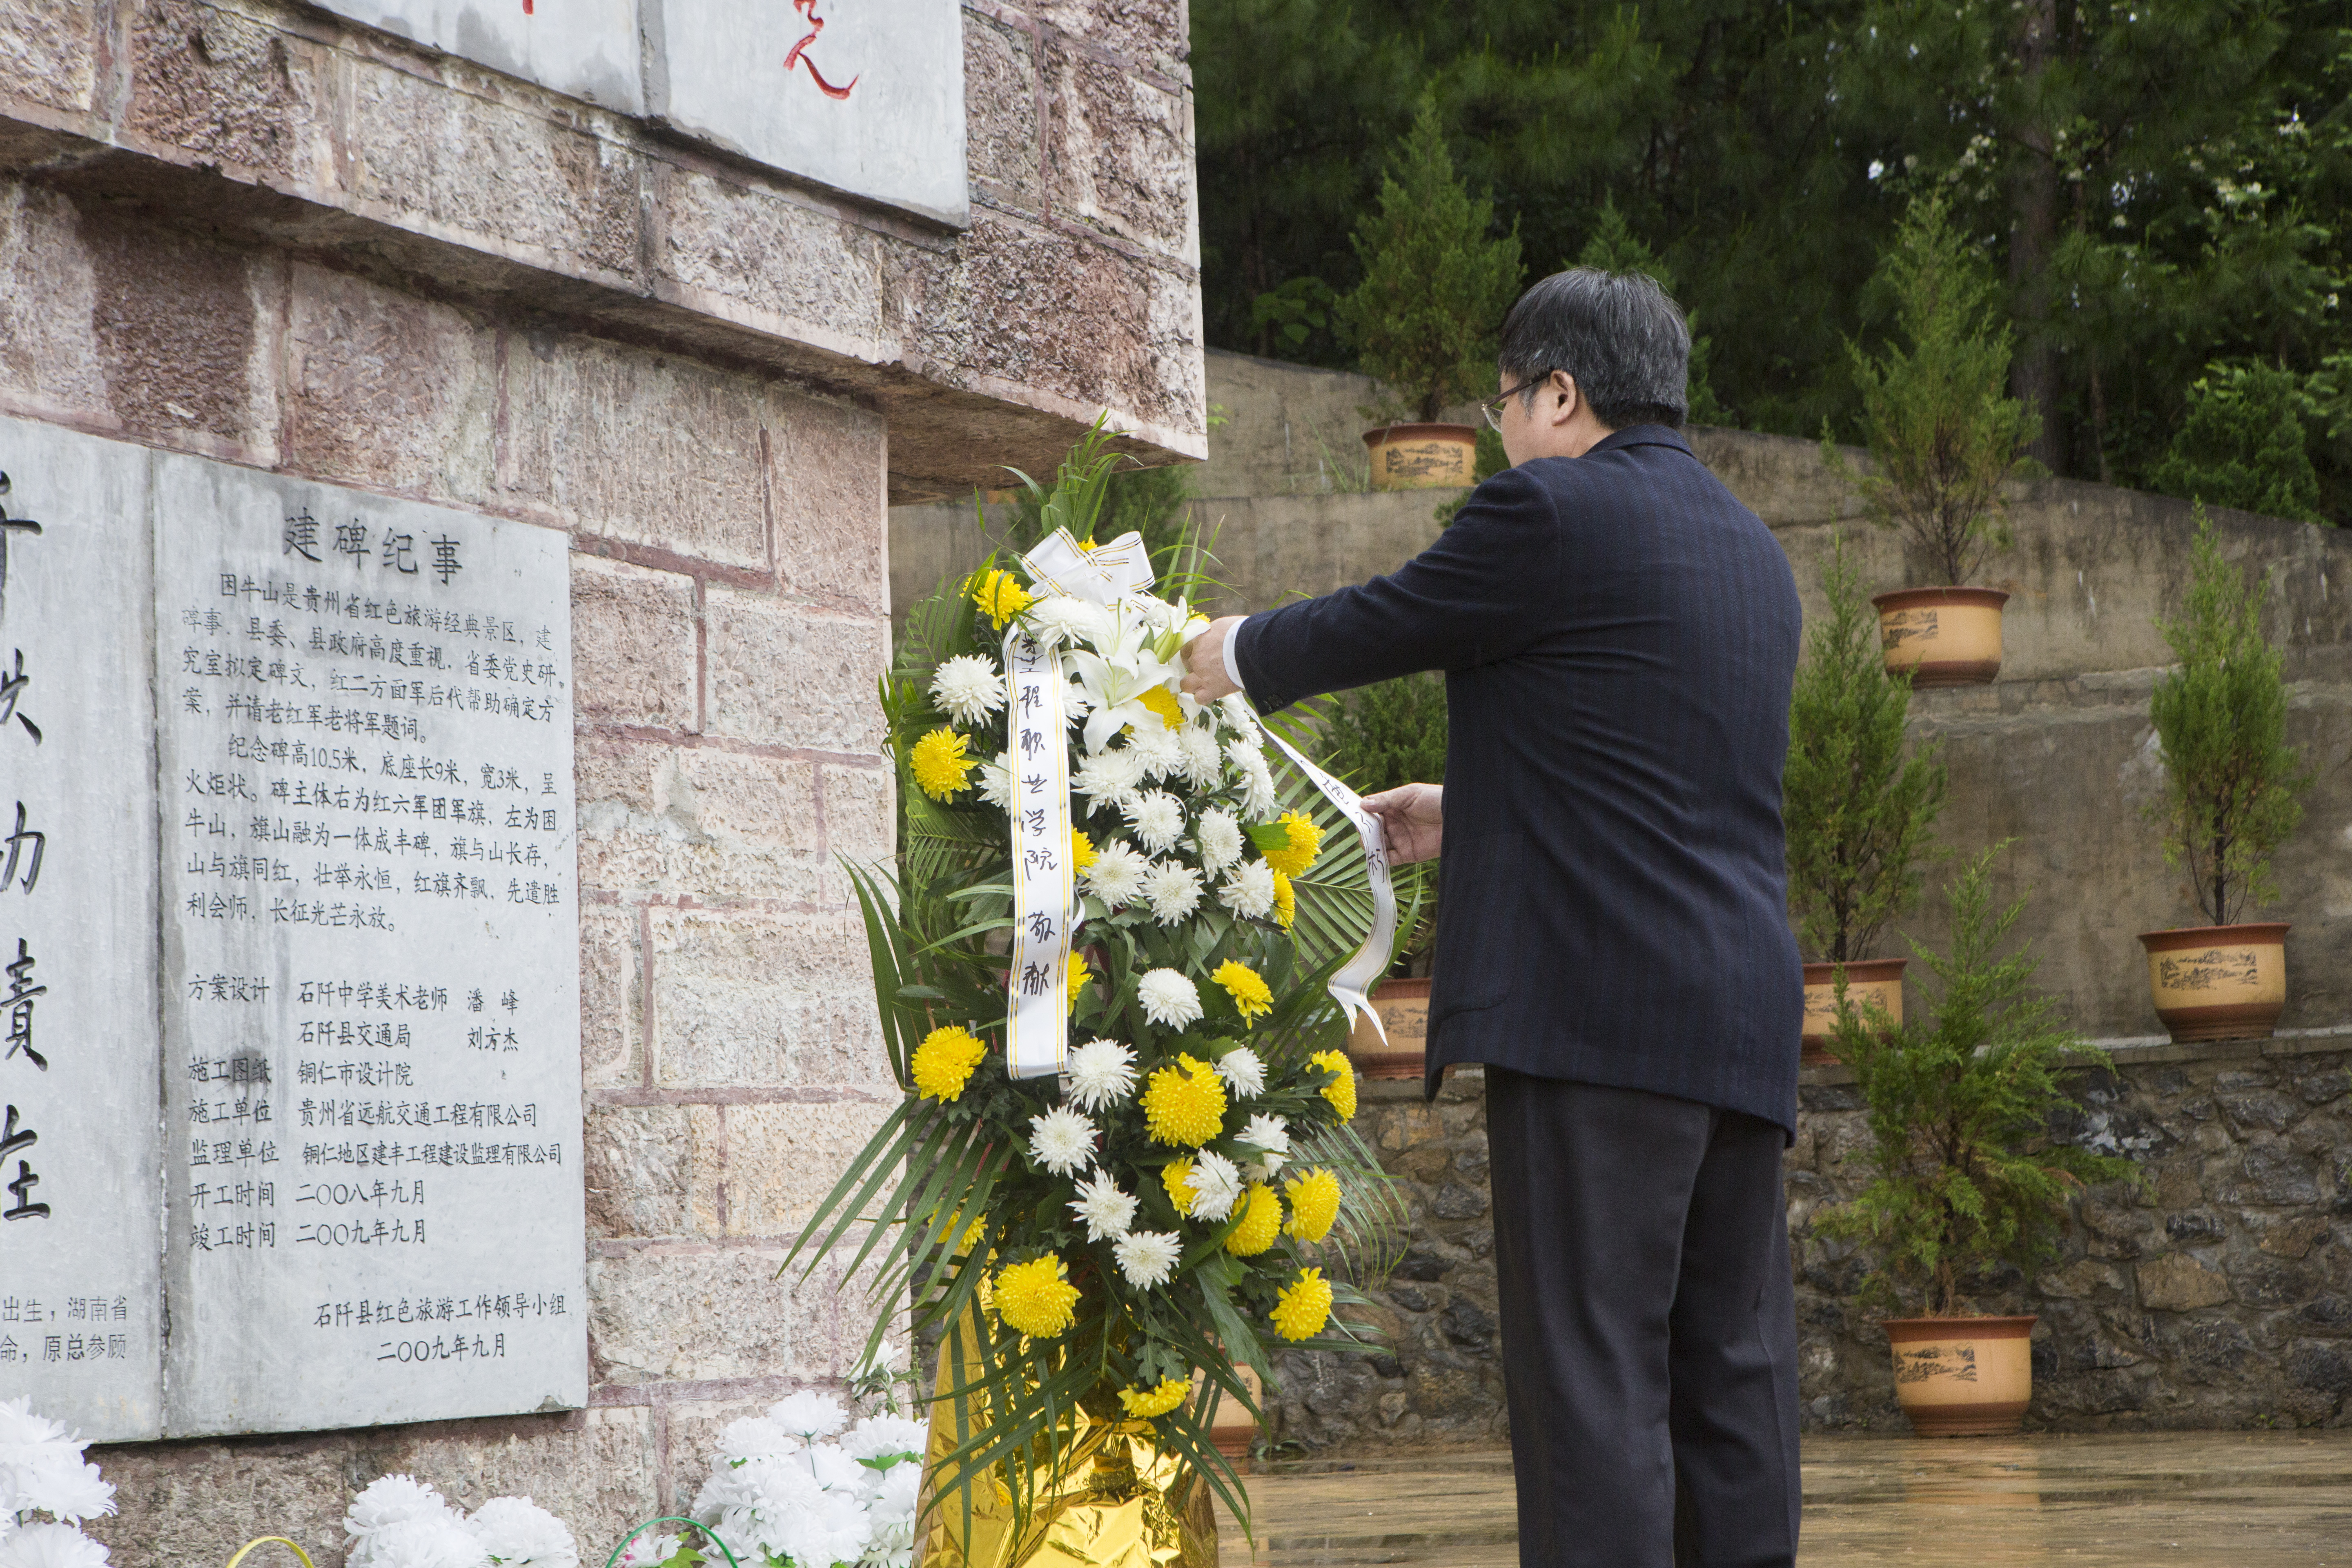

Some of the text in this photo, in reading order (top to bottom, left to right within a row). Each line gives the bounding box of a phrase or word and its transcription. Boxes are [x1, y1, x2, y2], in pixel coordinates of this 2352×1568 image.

[283, 506, 462, 586] 建碑纪事
[186, 891, 395, 933] 利会师，长征光芒永放。
[188, 974, 270, 1004] 方案设计
[297, 979, 448, 1013] 石阡中学美术老师
[297, 1020, 412, 1050] 石阡县交通局
[188, 1056, 414, 1088] 施工图纸 铜仁市设计院
[188, 1097, 537, 1129] 施工单位 贵州省远航交通工程有限公司
[190, 1138, 563, 1169] 监理单位 铜仁地区建丰工程建设监理有限公司
[190, 1178, 275, 1209] 开工时间
[190, 1221, 276, 1252] 竣工时间
[3, 1294, 127, 1323] 出生，湖南省
[313, 1292, 568, 1329] 石阡县红色旅游工作领导小组
[0, 1333, 126, 1363] 命，原总参顾
